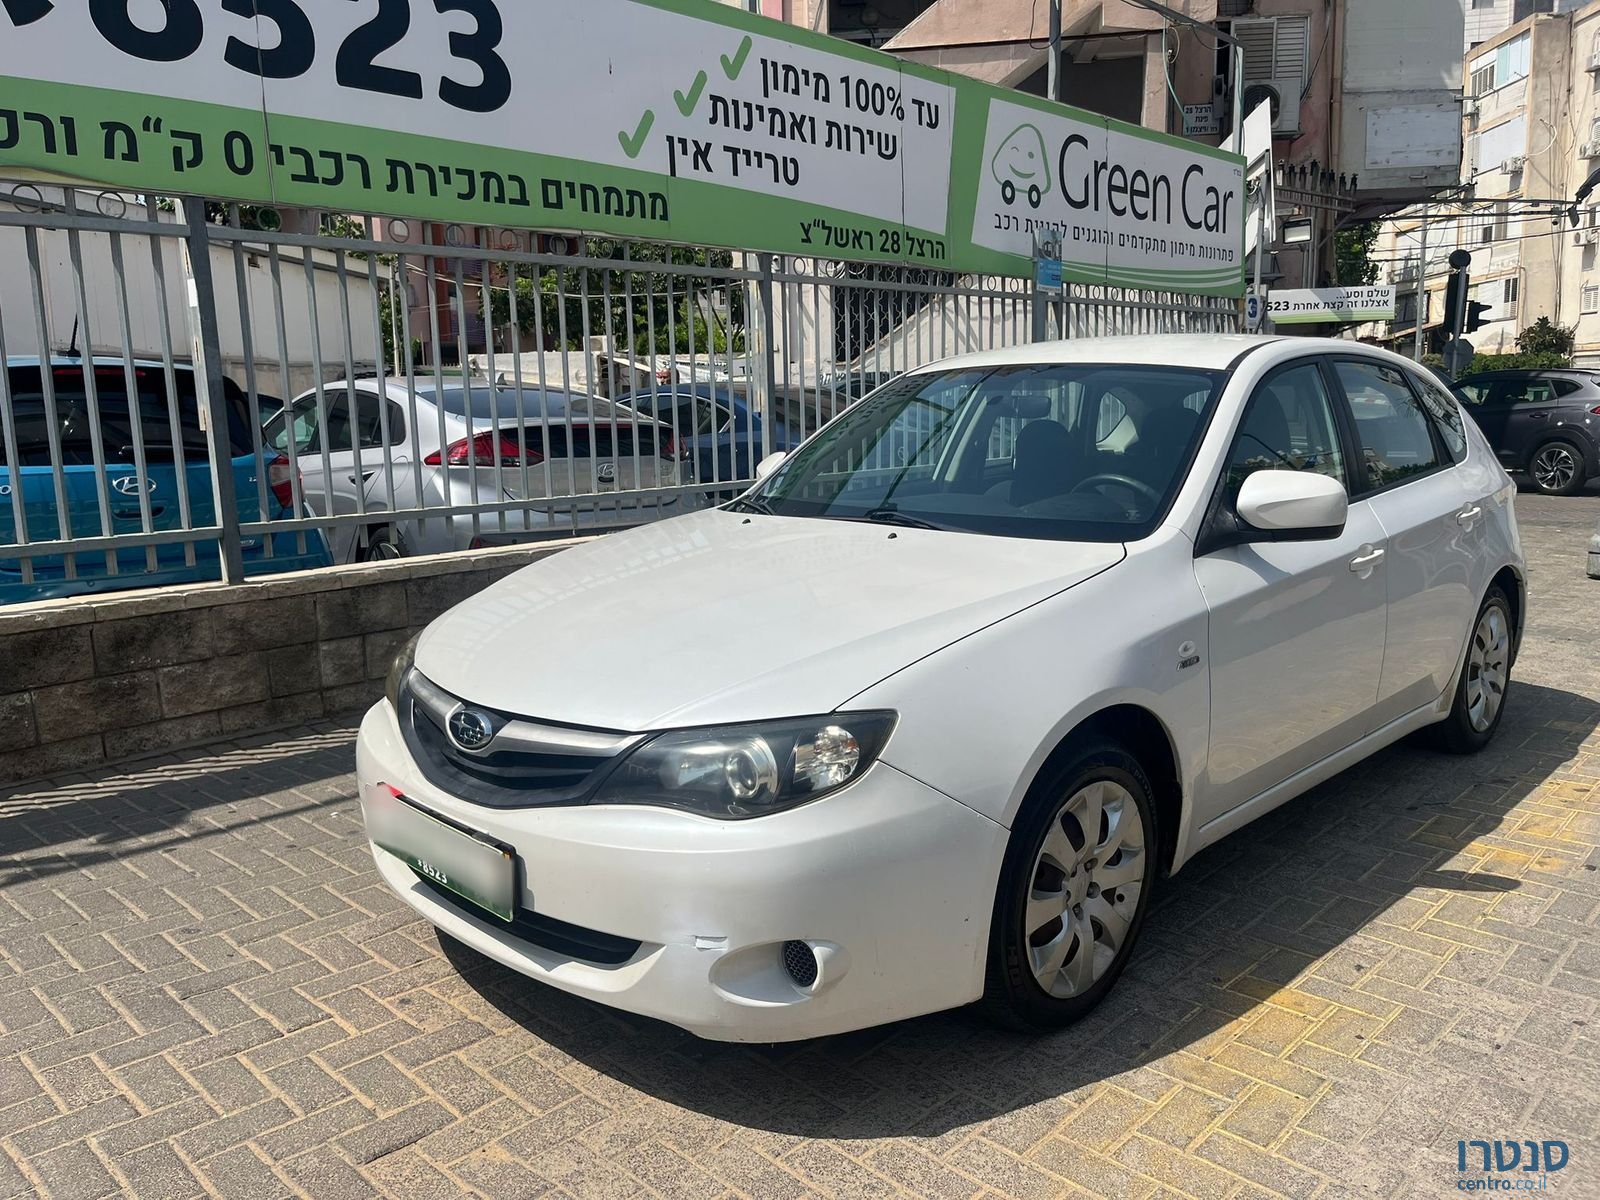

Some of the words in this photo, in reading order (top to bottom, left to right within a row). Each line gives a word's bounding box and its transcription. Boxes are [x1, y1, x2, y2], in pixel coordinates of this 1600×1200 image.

[760, 58, 831, 104] מימון
[840, 75, 905, 122] 100%
[709, 94, 816, 145] ואמינות
[912, 98, 940, 129] עד
[223, 130, 254, 176] 0
[825, 120, 897, 160] שירות
[270, 144, 372, 189] רכבי
[665, 135, 713, 177] אין
[723, 144, 800, 187] טרייד
[386, 158, 530, 207] במכירת
[1058, 133, 1171, 224] Green
[1181, 163, 1234, 234] Car
[541, 178, 669, 221] מתמחים
[994, 213, 1019, 232] רכב
[1073, 226, 1114, 246] והוגנים
[879, 229, 901, 254] 28
[906, 232, 945, 260] הרצל
[1119, 233, 1166, 255] מתקדמים
[1170, 241, 1195, 258] מימון
[1198, 245, 1234, 262] פתרונות
[1293, 302, 1320, 311] אחרת
[1323, 301, 1343, 311] קצת
[1346, 300, 1358, 308] זה
[1361, 299, 1389, 308] אצלנו
[1367, 289, 1390, 298] שלם
